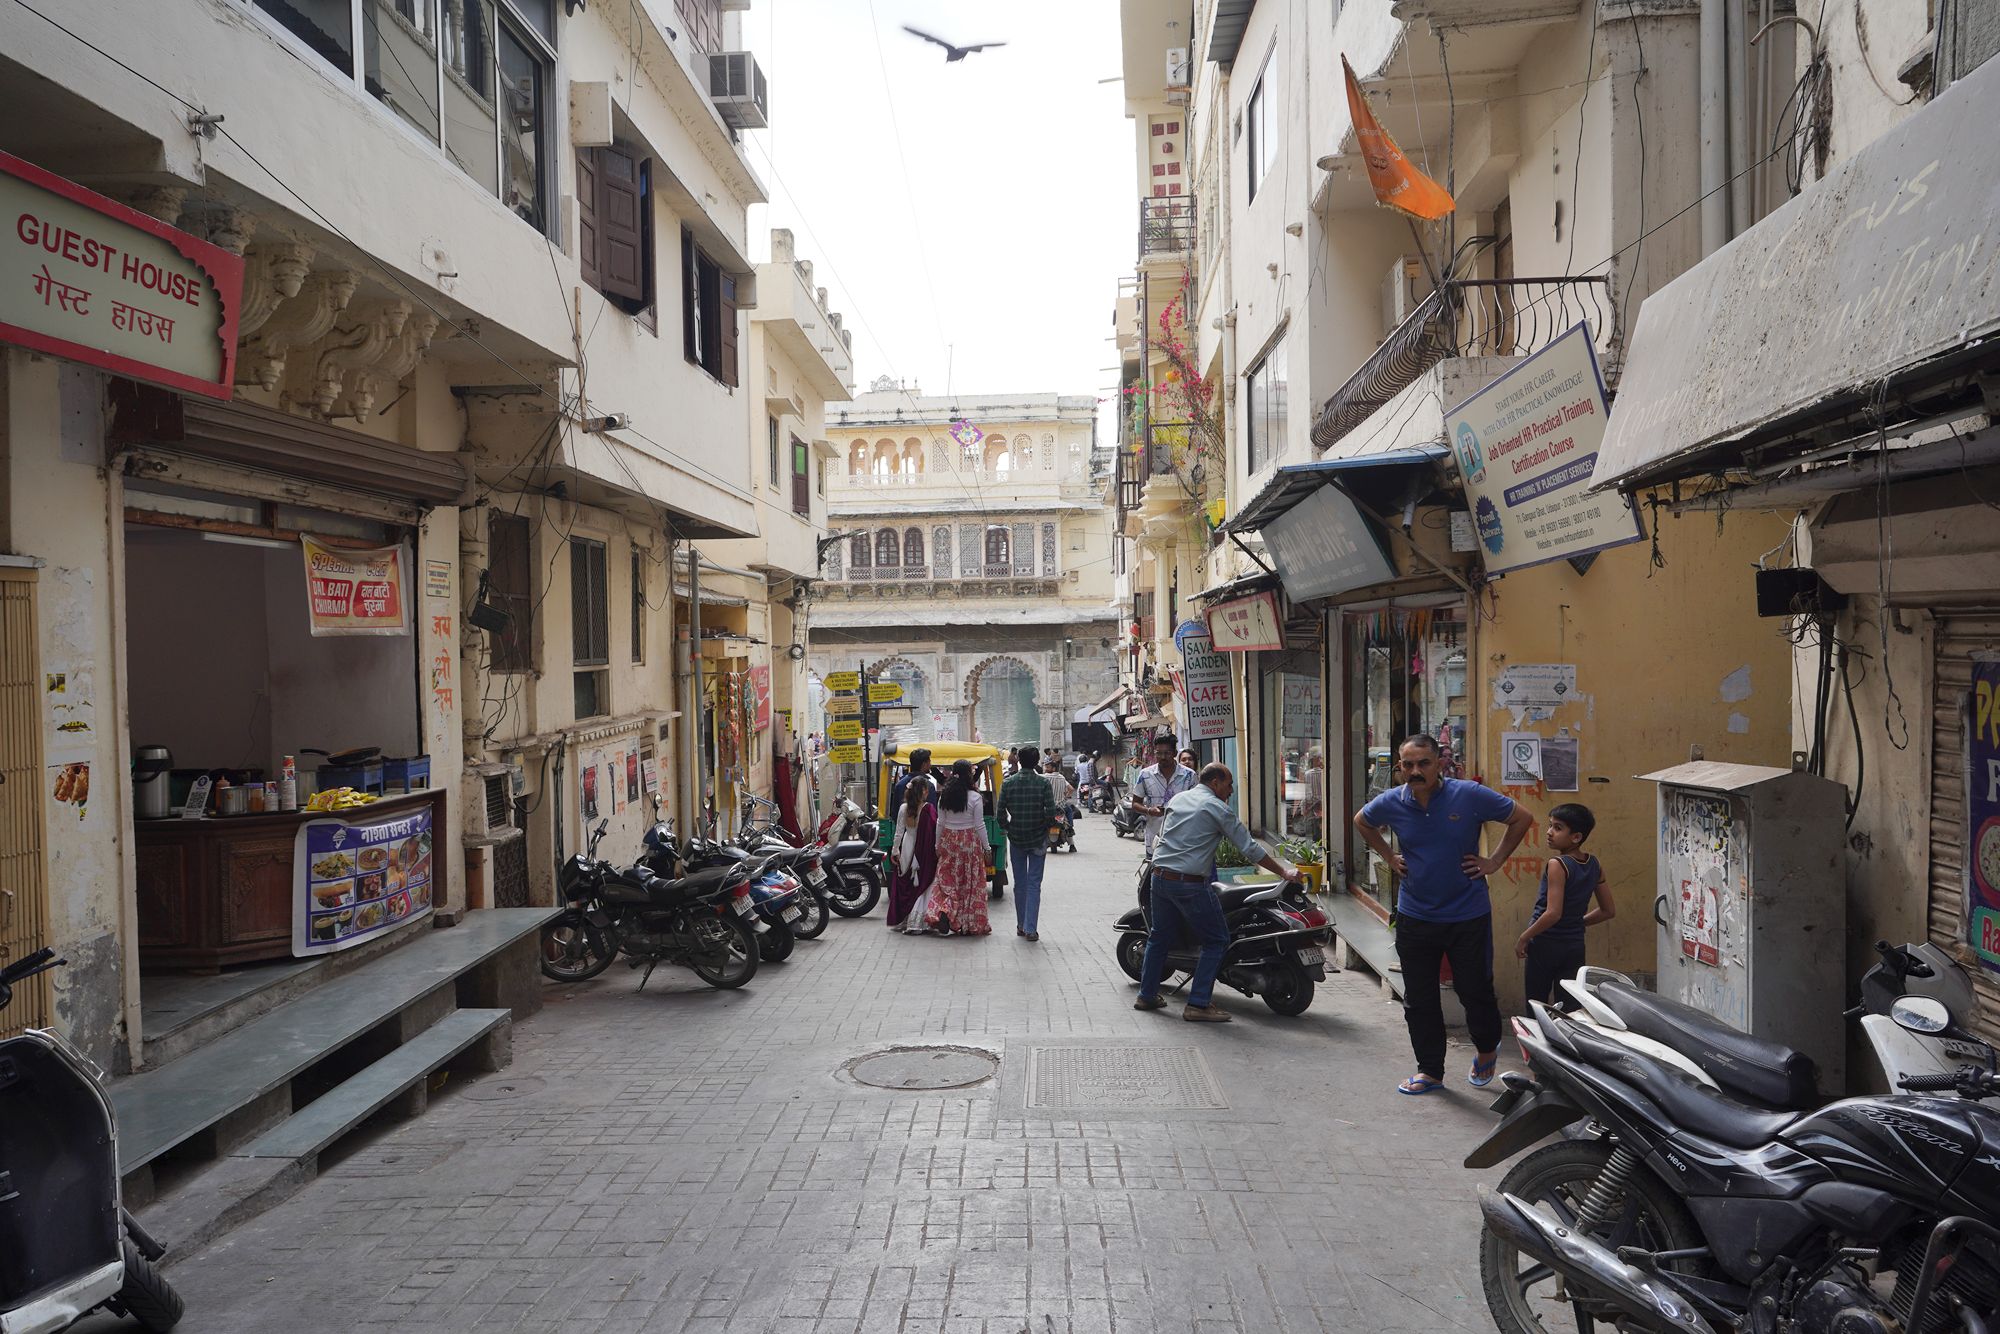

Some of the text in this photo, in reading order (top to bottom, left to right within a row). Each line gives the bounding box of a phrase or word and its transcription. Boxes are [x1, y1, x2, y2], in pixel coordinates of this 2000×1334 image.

[17, 213, 201, 307] GUEST HOUSE
[32, 264, 175, 344] गेस्ट हाउस
[1495, 397, 1509, 414] START
[1524, 381, 1535, 395] HR
[1534, 368, 1557, 389] CAREER
[1506, 410, 1517, 425] HR
[1515, 396, 1544, 418] PRACTICAL
[1543, 370, 1584, 403] KNOWLEDGE!
[1488, 397, 1595, 462] Job Oriented HR Practical Training
[1511, 436, 1575, 475] Certification Course
[1515, 483, 1536, 501] TRAINING
[1541, 470, 1569, 491] PLACEMENT
[1568, 459, 1594, 479] SERVICES
[312, 580, 350, 598] DAL BATI
[314, 598, 347, 615] CHURMA
[363, 599, 386, 617] चूरमा
[1187, 656, 1228, 671] GARDEN
[1191, 684, 1229, 703] CAFE
[1191, 704, 1232, 719] EDELWEISS
[1199, 719, 1225, 728] GERMAN
[1201, 727, 1225, 736] BAKERY
[1666, 1152, 1687, 1172] Hero
